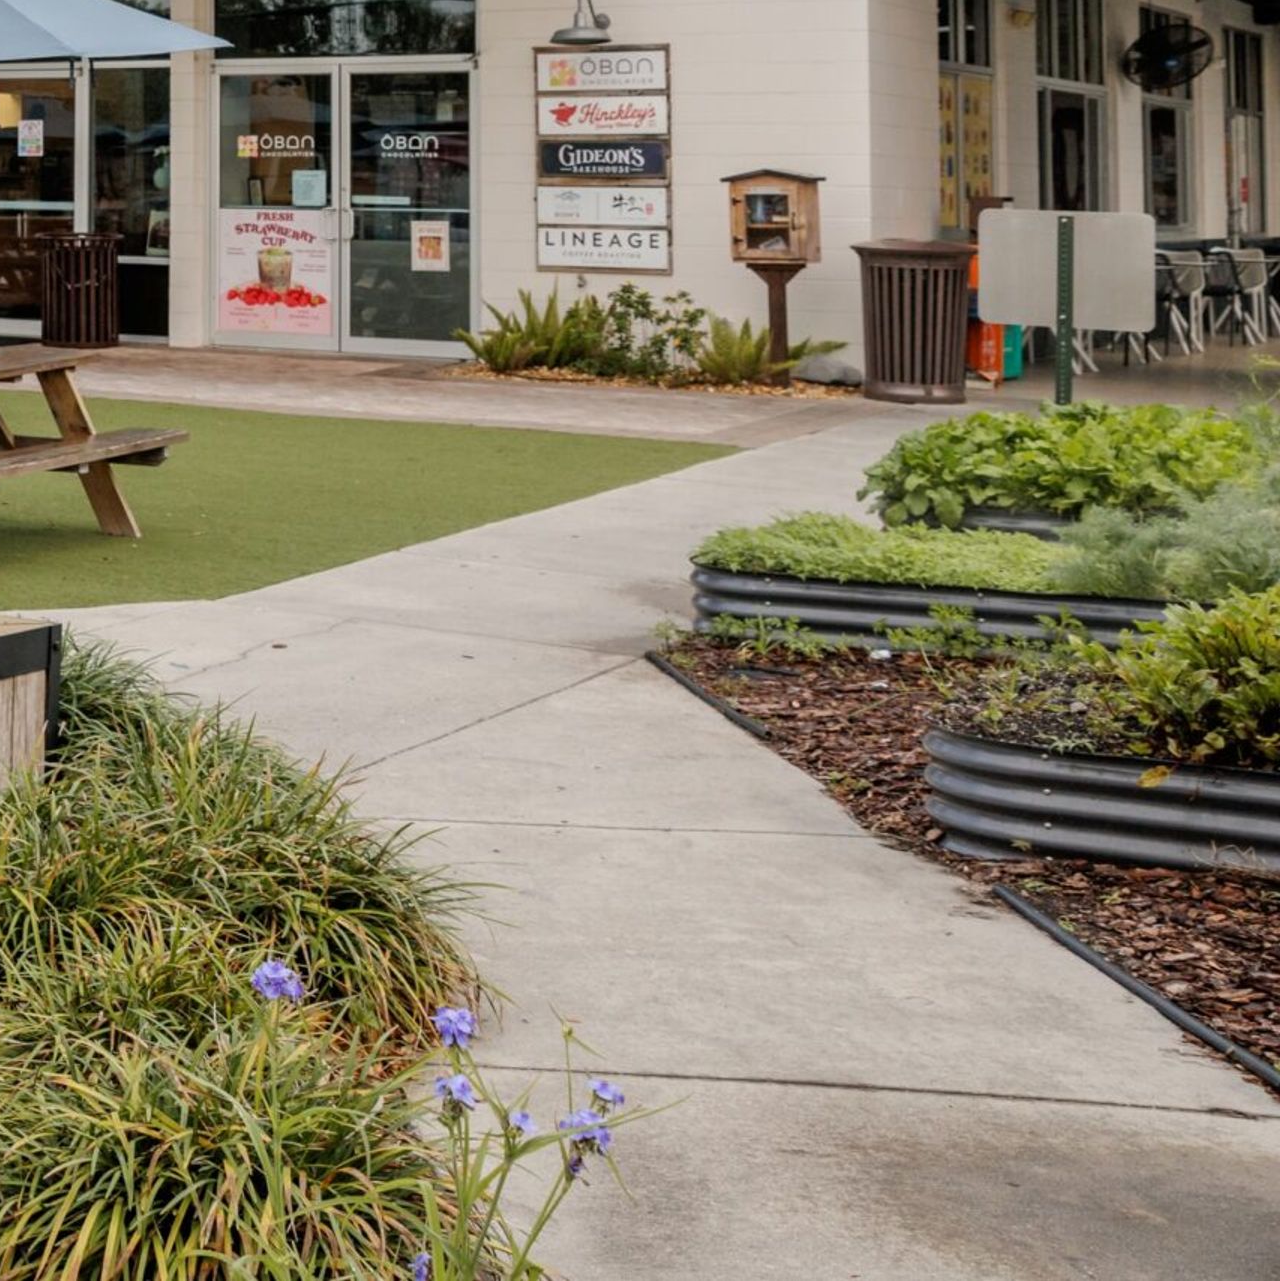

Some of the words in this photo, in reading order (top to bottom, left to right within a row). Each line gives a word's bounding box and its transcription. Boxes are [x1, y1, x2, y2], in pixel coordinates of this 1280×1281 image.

[578, 102, 656, 128] Hinckley's
[558, 144, 645, 167] GIDEON'S
[572, 165, 630, 174] BAKEHOUSE
[256, 212, 294, 222] FRESH
[234, 223, 318, 244] STRAWBERRY
[261, 237, 286, 246] CUP
[545, 230, 660, 249] LINEAGE
